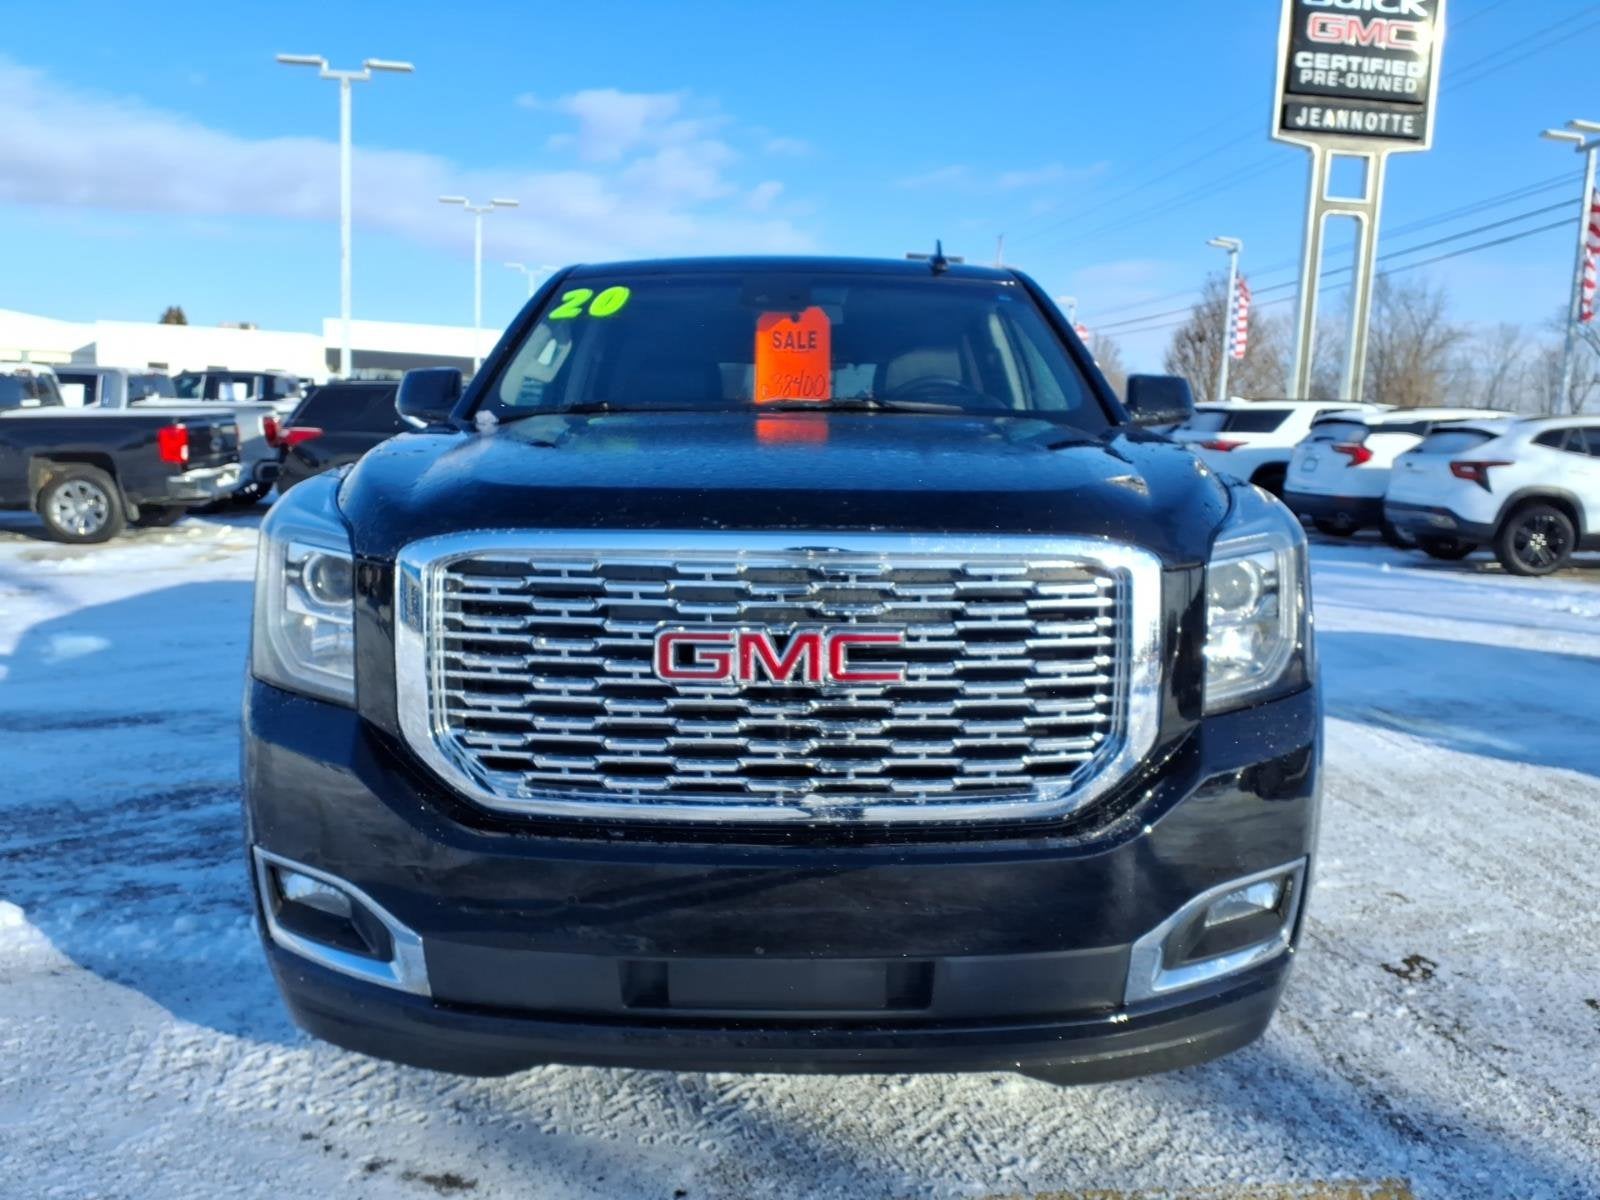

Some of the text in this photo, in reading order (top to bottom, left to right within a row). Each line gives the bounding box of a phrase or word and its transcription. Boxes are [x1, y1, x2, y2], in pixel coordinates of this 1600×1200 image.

[1307, 11, 1421, 50] GMC
[1294, 51, 1425, 78] CERTIFIED
[1299, 69, 1417, 93] PRE-OWNED
[1295, 106, 1415, 134] JEANNOTTE
[548, 285, 631, 320] 20
[772, 330, 817, 350] SALE
[653, 621, 907, 688] GMC
